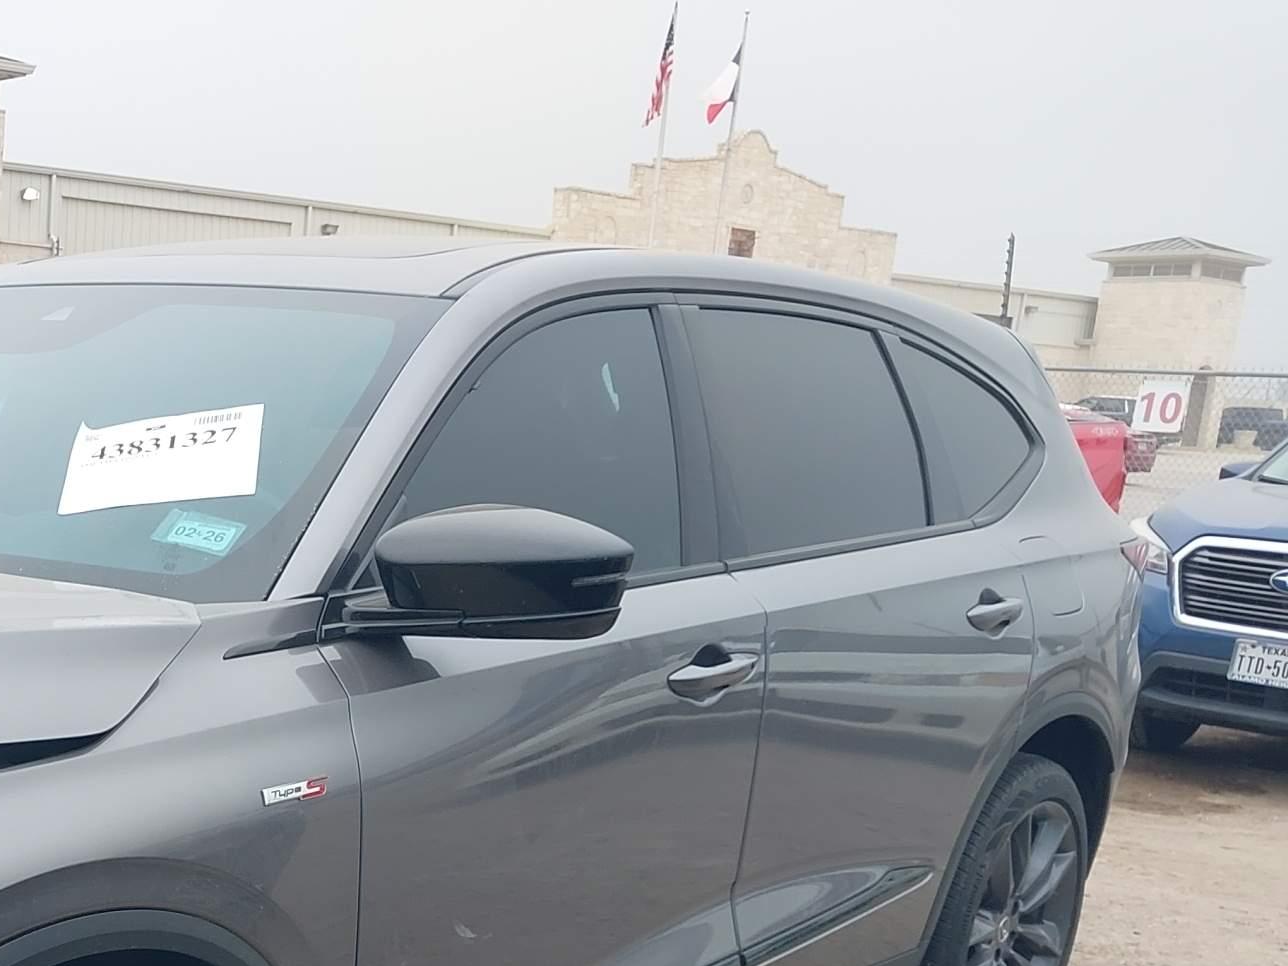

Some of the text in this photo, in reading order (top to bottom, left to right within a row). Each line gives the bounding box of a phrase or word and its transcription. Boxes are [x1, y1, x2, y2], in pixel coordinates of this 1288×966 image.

[1141, 391, 1183, 424] 10
[91, 427, 237, 460] 43831327
[272, 776, 328, 800] Type S
